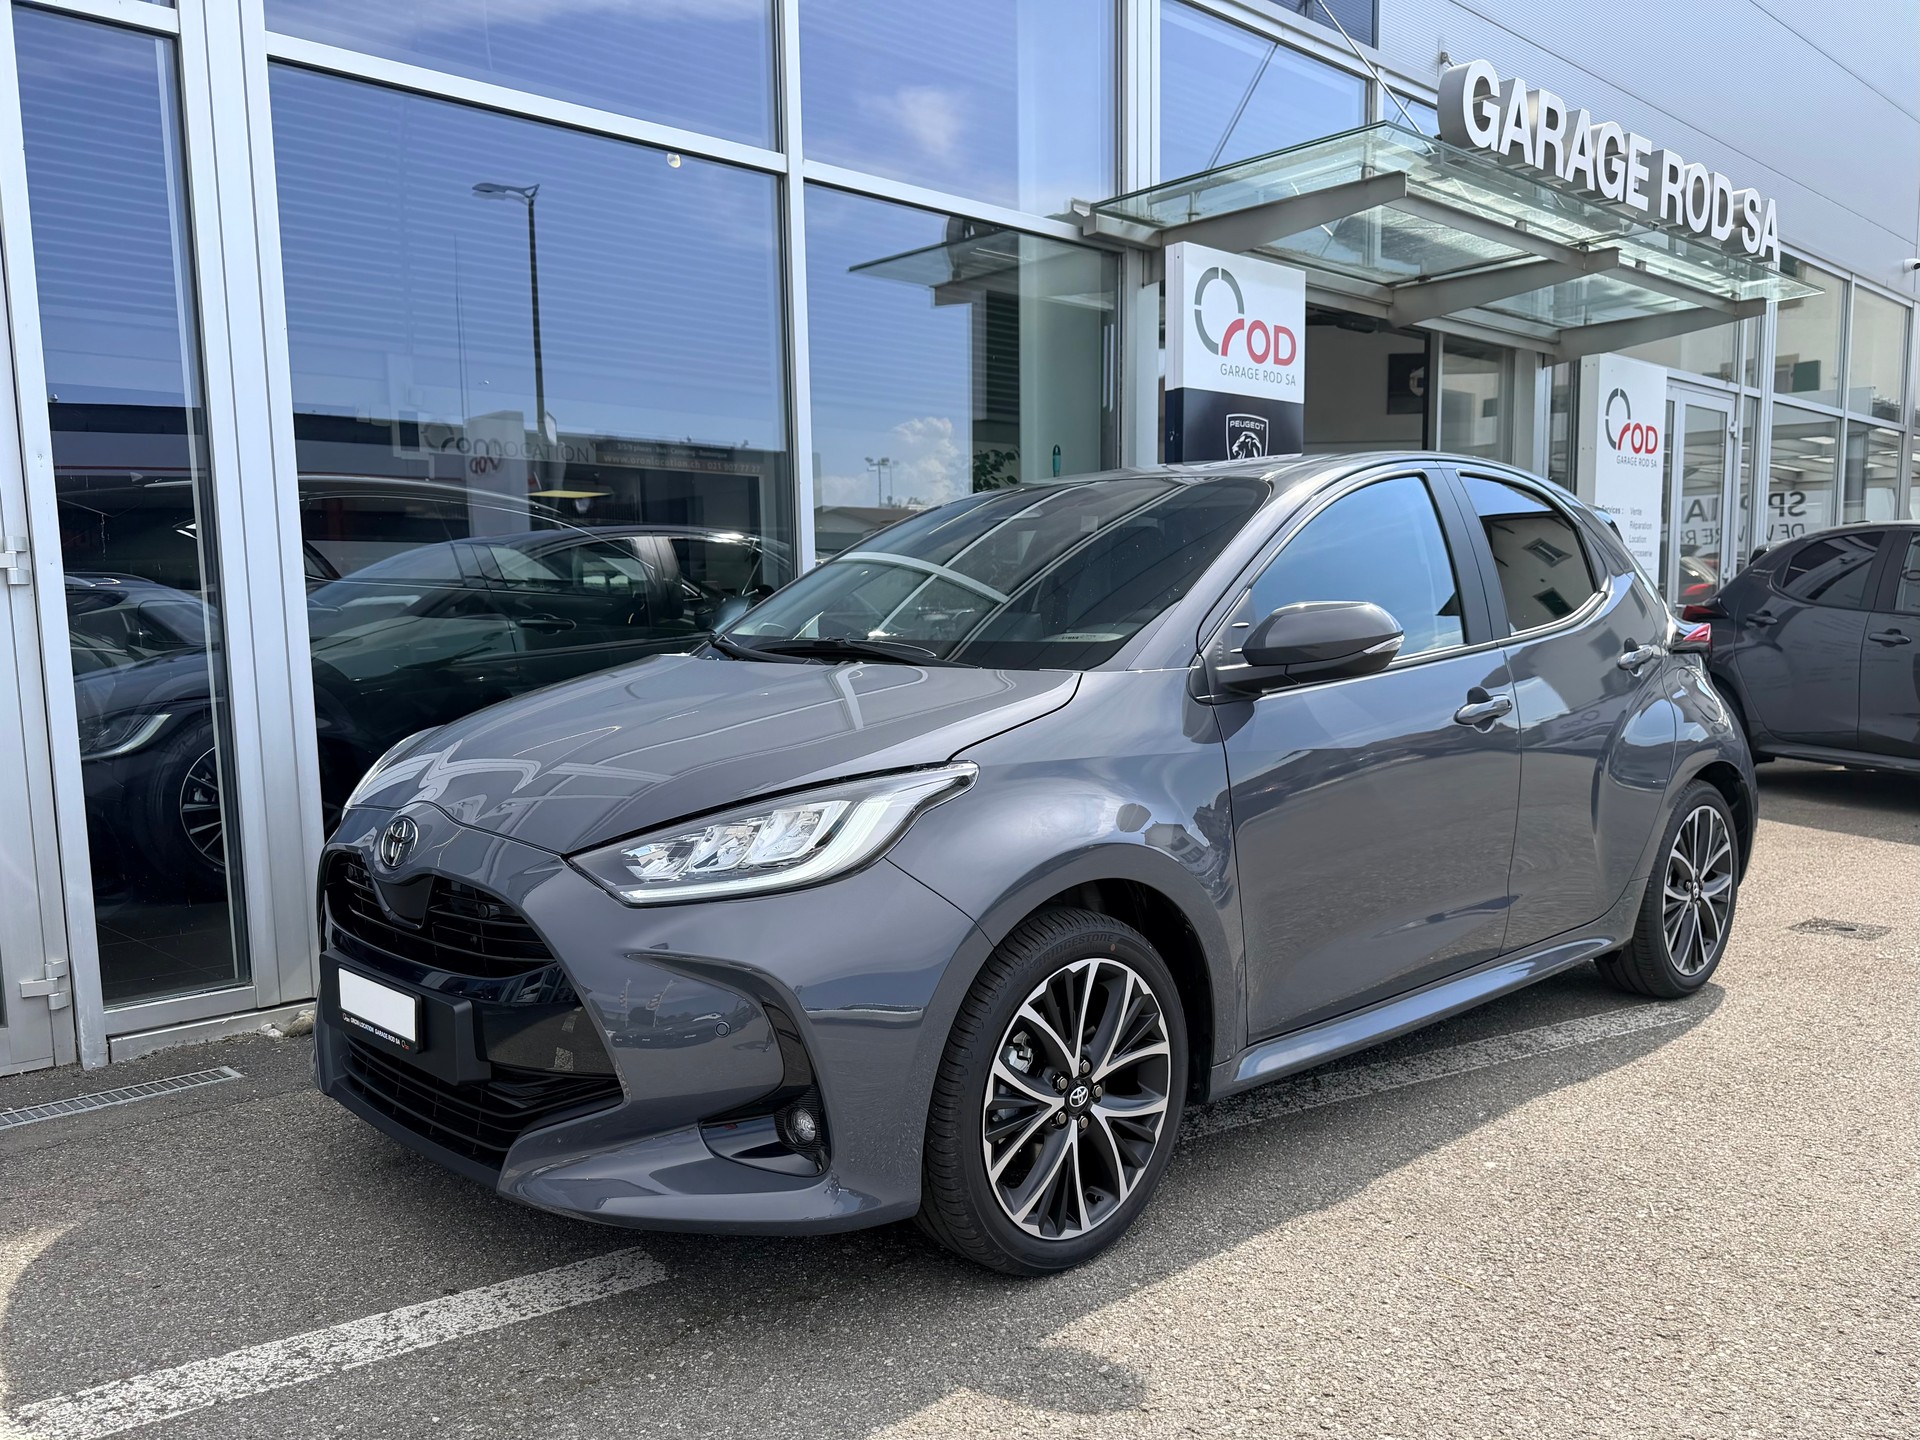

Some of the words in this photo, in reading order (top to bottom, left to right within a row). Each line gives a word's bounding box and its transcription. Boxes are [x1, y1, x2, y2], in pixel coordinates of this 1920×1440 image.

[1460, 59, 1653, 212] GARAGE
[1658, 148, 1734, 242] ROD
[1740, 187, 1780, 262] SA
[1219, 363, 1260, 381] GARAGE
[1263, 369, 1283, 384] ROD
[1285, 373, 1297, 387] SA
[1229, 420, 1265, 431] PEUGEOT
[494, 440, 590, 463] LOCATION
[1616, 455, 1637, 467] GARAGE
[1638, 457, 1650, 468] ROD
[1650, 458, 1658, 469] SA
[1032, 933, 1114, 969] BRIDGESTONE
[374, 1028, 388, 1040] GARAGE
